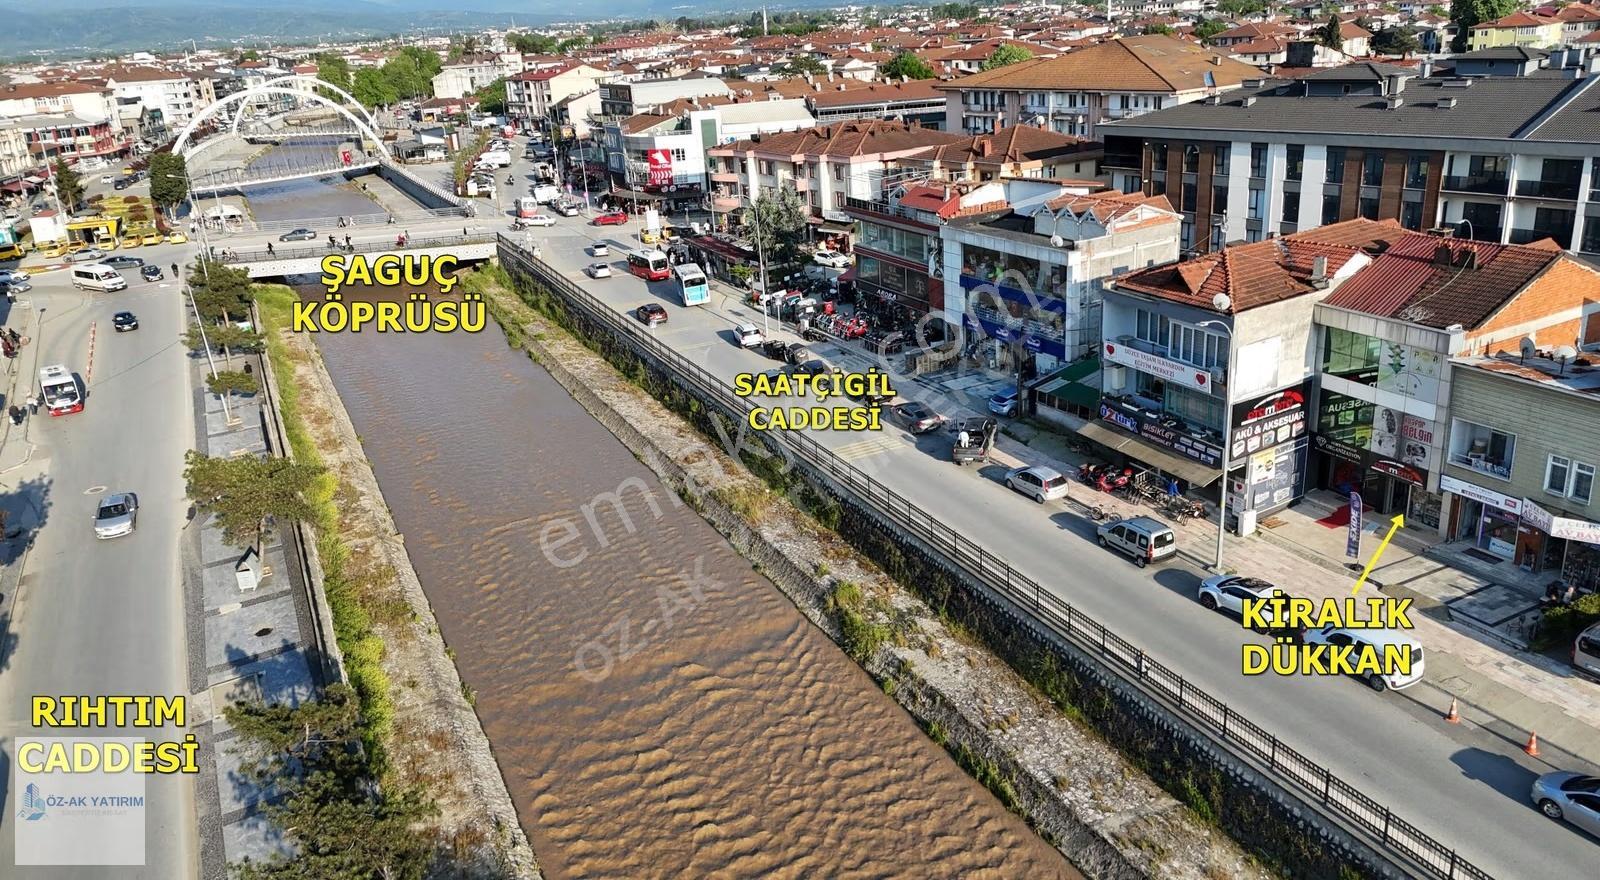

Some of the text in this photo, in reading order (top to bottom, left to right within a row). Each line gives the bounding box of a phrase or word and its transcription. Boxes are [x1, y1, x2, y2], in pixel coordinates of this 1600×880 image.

[1235, 411, 1305, 441] AKÜ & AKSESUAR
